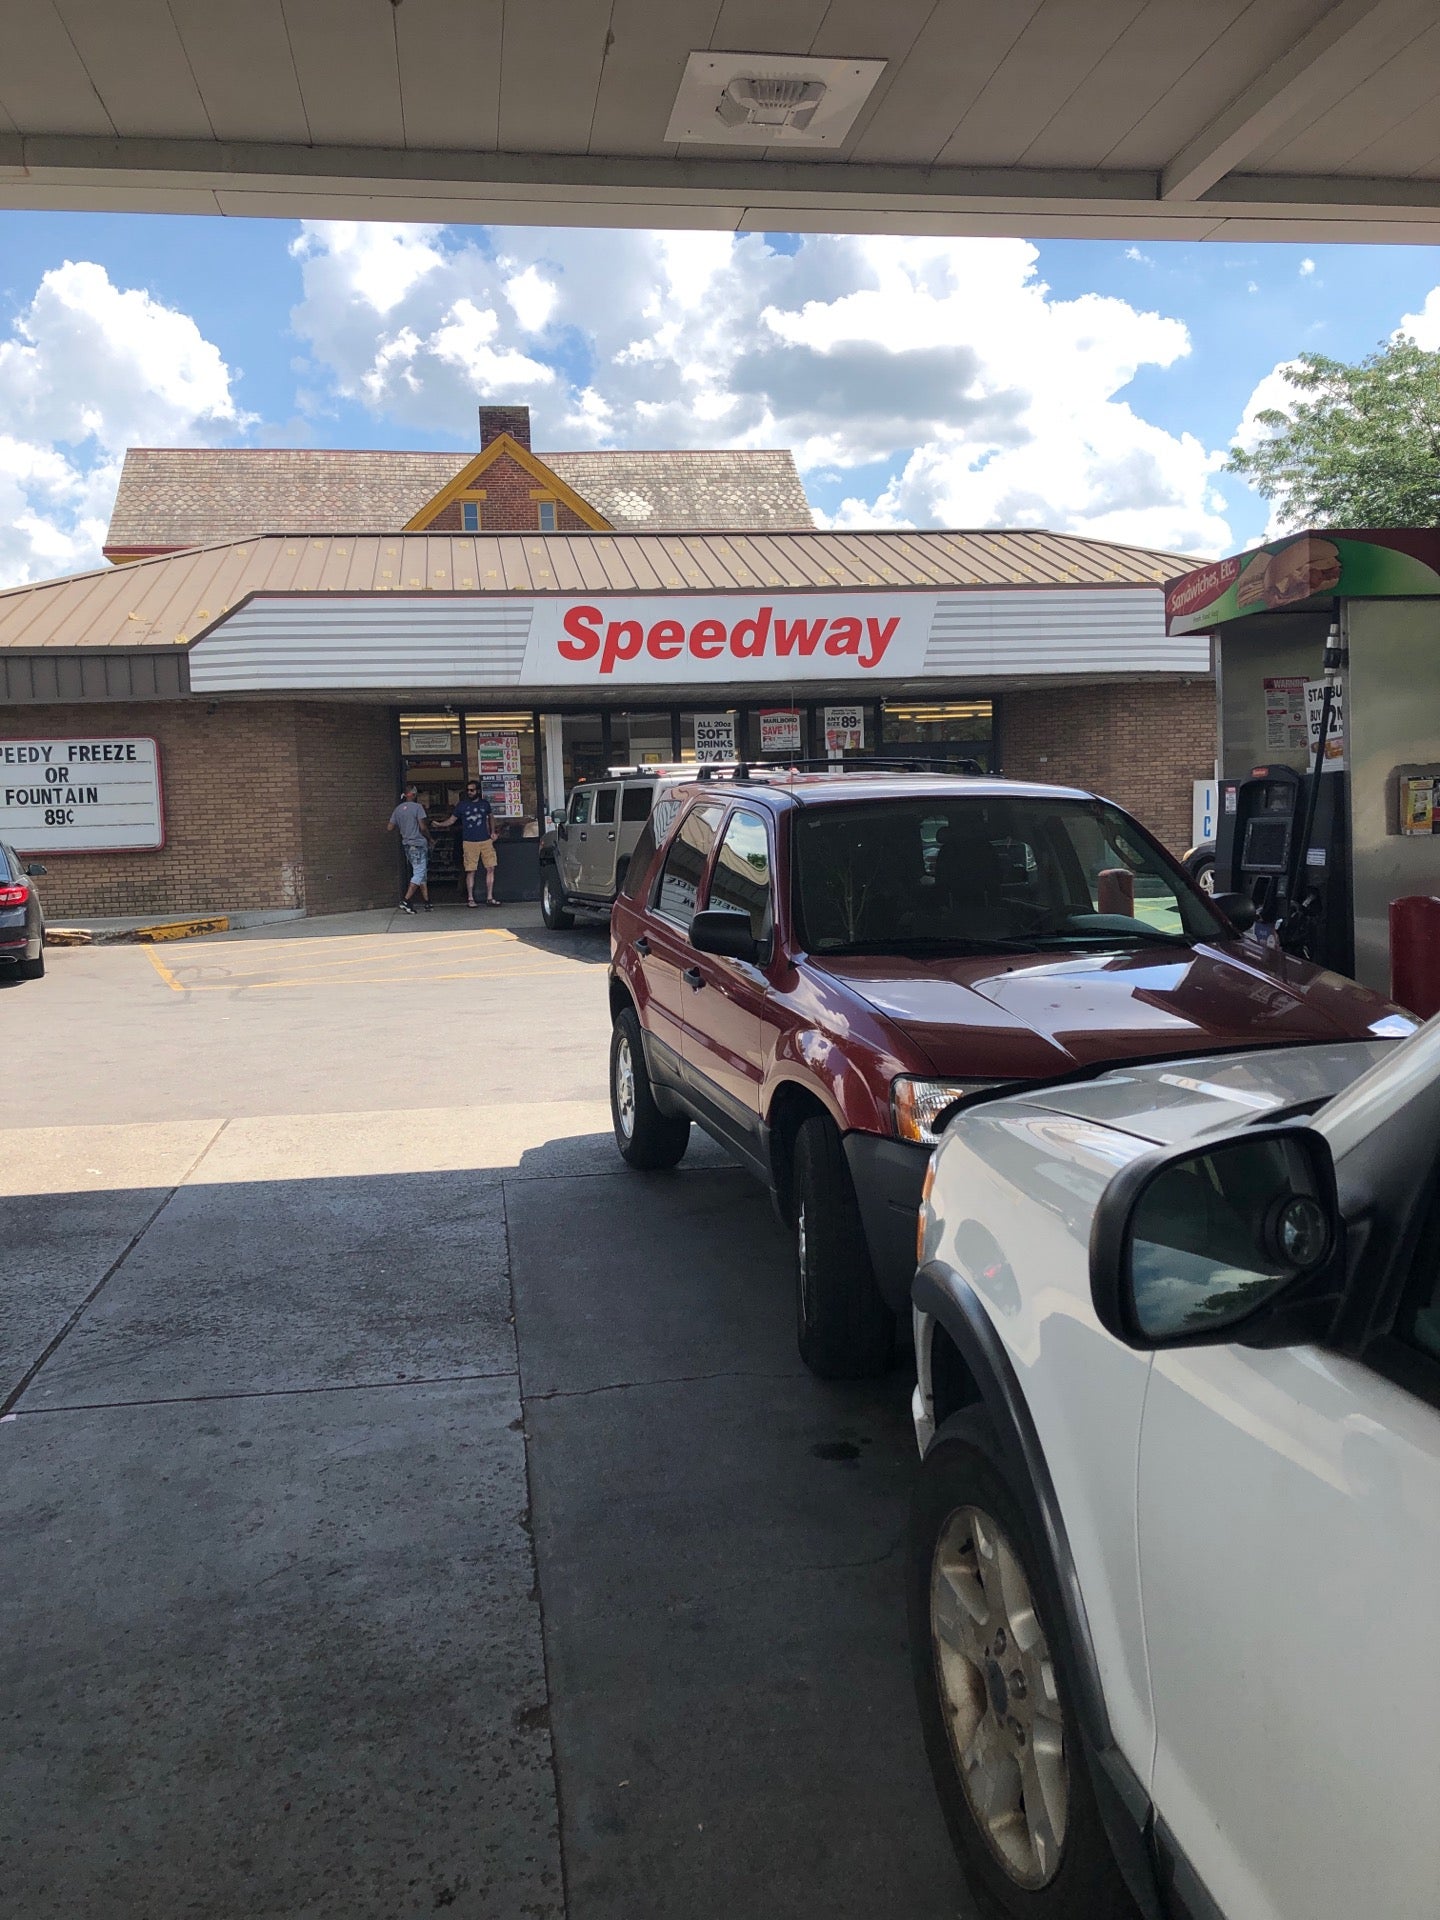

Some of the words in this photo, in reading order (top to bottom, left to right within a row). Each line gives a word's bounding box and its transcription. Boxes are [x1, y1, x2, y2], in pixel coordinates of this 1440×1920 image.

[1220, 561, 1236, 579] Etc.
[557, 605, 901, 674] Speedway
[697, 729, 732, 740] SOFT
[762, 725, 783, 736] SAVE
[68, 744, 137, 762] FREEZE
[697, 740, 733, 749] DRINKS
[45, 767, 69, 784] OR
[5, 787, 98, 805] FOUNTAIN
[44, 808, 74, 826] 89¢
